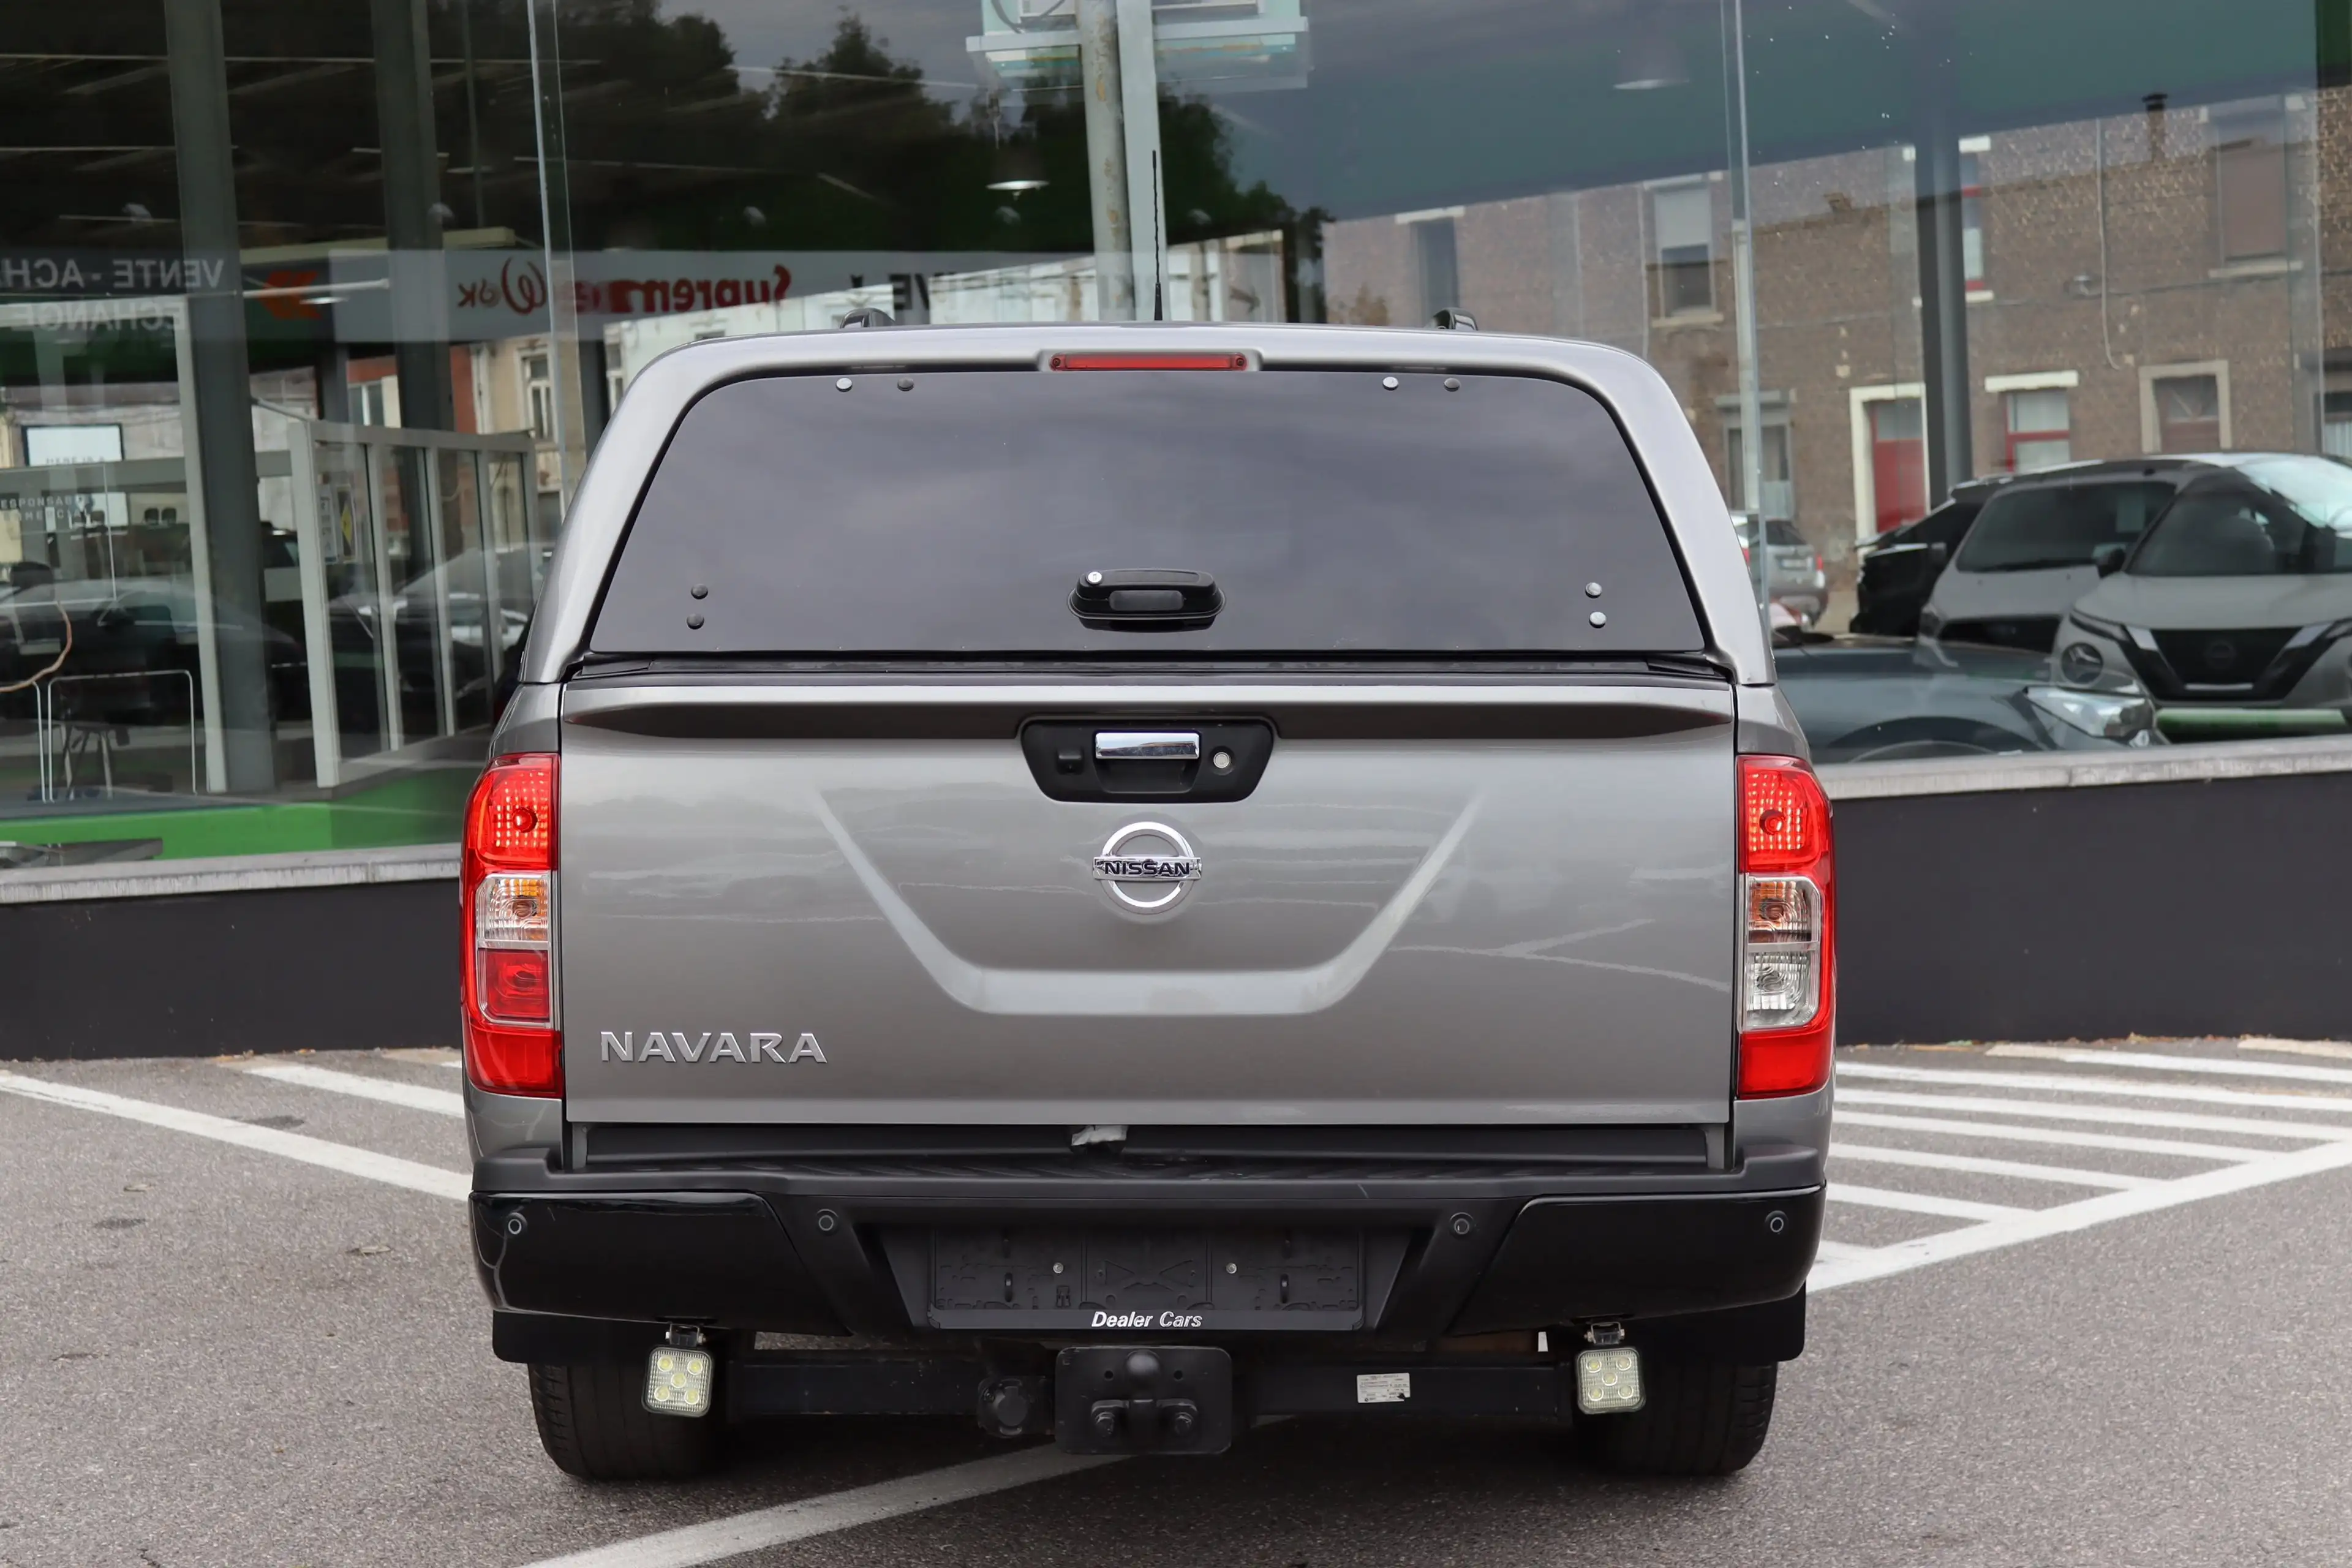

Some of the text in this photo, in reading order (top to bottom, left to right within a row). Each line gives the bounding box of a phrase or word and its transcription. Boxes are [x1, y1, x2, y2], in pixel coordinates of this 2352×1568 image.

[1104, 861, 1191, 876] NISSAN
[600, 1031, 827, 1063] NAVARA
[1091, 1311, 1202, 1328] Dealer Cars
